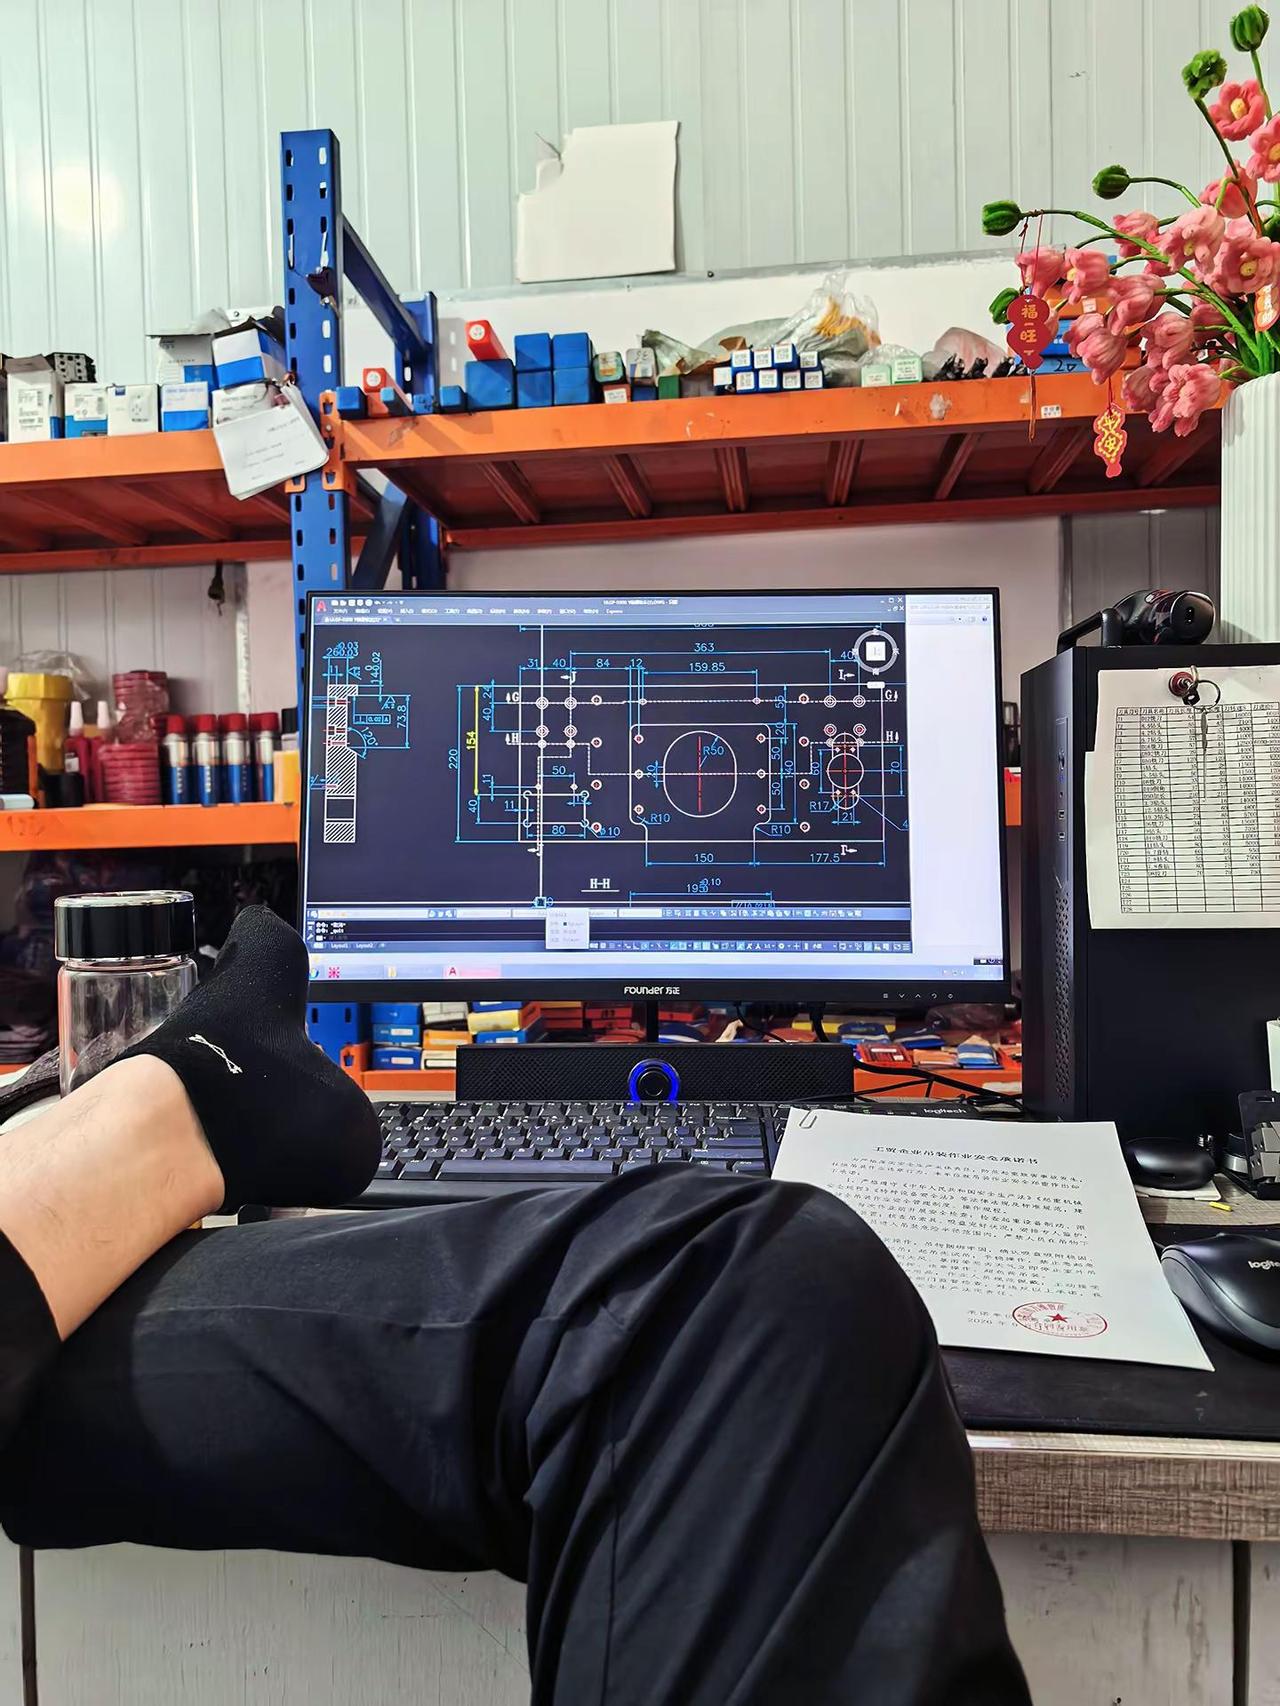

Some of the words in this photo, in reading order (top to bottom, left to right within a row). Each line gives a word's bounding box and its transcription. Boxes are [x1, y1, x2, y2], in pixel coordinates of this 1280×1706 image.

[694, 642, 715, 652] 363
[840, 650, 854, 660] 40
[527, 658, 538, 668] 31
[552, 658, 566, 668] 40
[596, 658, 610, 668] 84
[630, 658, 643, 668] 12
[689, 662, 726, 672] 159.85
[512, 692, 520, 702] G
[885, 690, 892, 700] G
[775, 695, 784, 708] 55
[396, 704, 406, 728] 73.8
[482, 707, 492, 721] 40
[775, 722, 785, 736] 20
[466, 730, 476, 750] 154
[511, 732, 519, 742] H
[886, 730, 894, 742] H
[703, 746, 724, 756] R50
[771, 746, 782, 760] 50
[448, 748, 458, 770] 220
[552, 766, 566, 775] 50
[785, 760, 794, 778] 140
[890, 761, 900, 774] 70
[772, 782, 782, 796] 50
[468, 799, 478, 814] 40
[504, 800, 514, 810] 11
[650, 814, 670, 822] R10
[842, 812, 854, 820] 21
[552, 826, 566, 835] 80
[771, 825, 791, 834] R10
[694, 853, 714, 863] 150
[810, 853, 840, 863] 177.5
[665, 986, 680, 995] 方正
